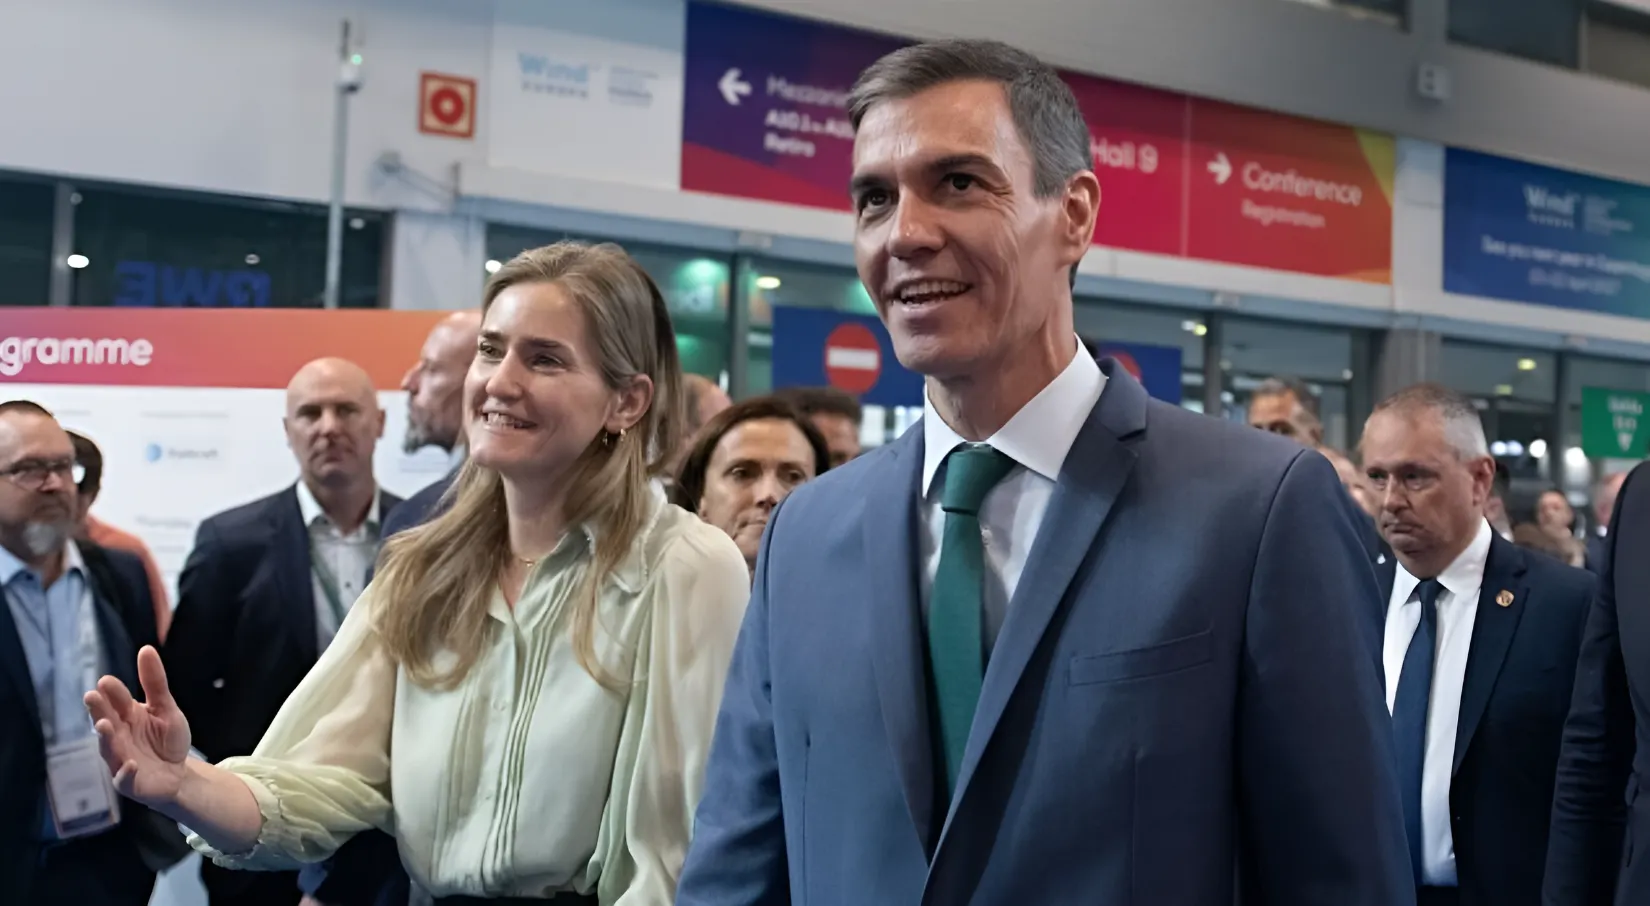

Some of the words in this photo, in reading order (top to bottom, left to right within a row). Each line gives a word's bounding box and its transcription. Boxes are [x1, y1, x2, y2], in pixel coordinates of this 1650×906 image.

[1090, 136, 1135, 170] Hall
[1138, 143, 1158, 174] 9
[1242, 161, 1363, 206] Conference
[0, 336, 154, 376] gramme
